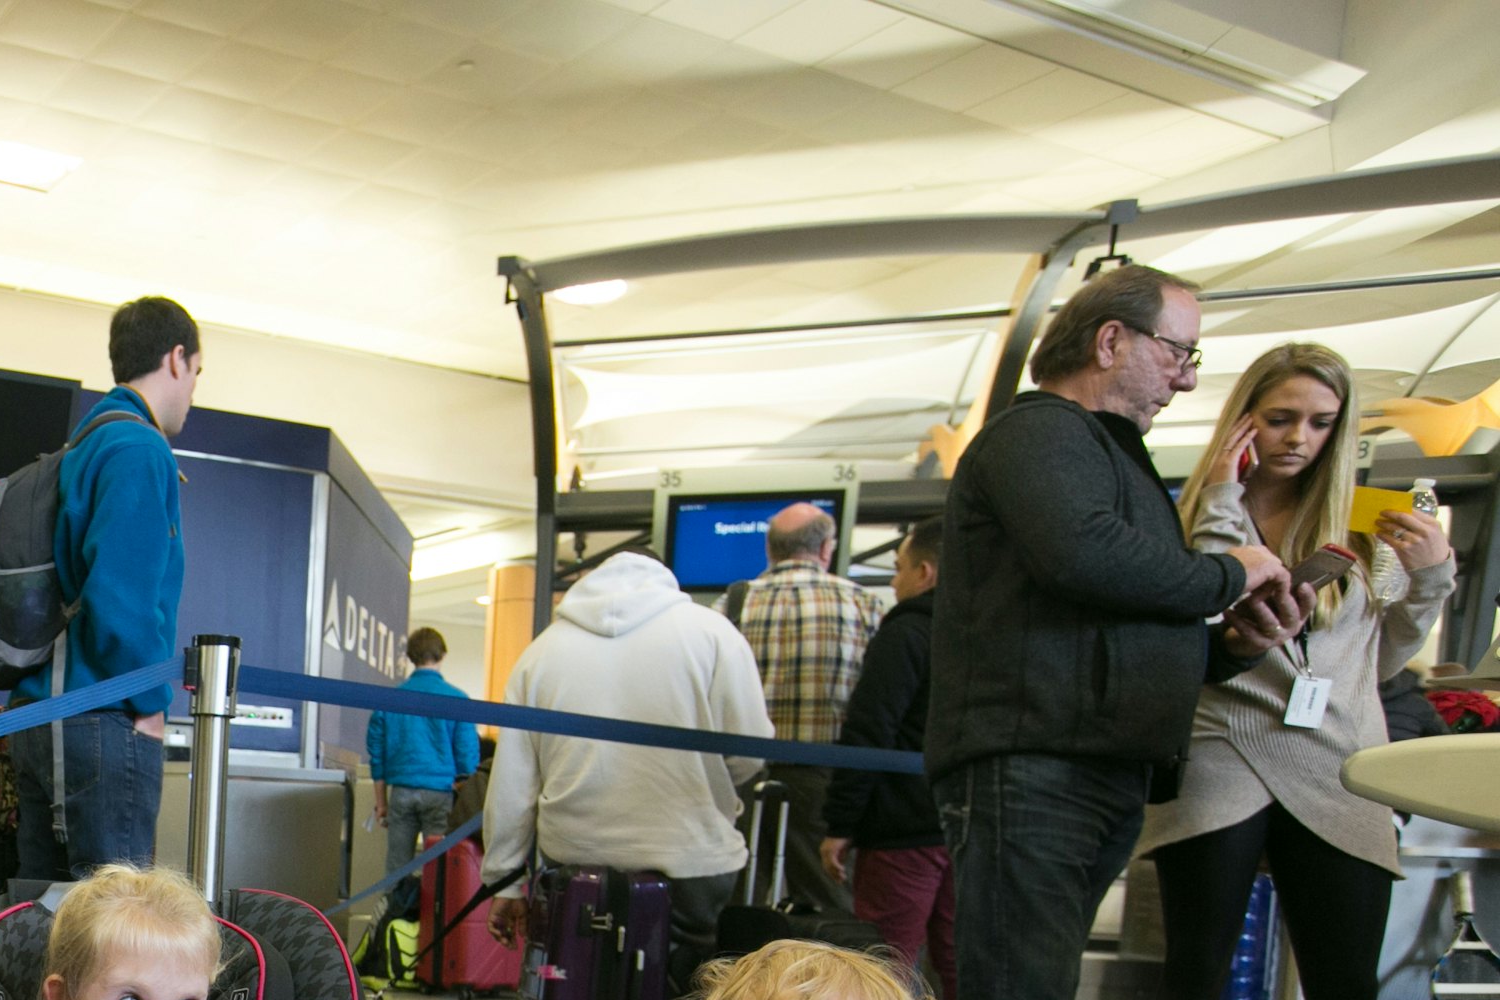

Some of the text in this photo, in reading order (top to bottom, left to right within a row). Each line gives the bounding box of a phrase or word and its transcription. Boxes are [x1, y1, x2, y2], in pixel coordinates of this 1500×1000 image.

[660, 470, 682, 488] 35
[833, 464, 857, 482] 36
[714, 521, 756, 536] Special
[344, 594, 395, 680] DELTA
